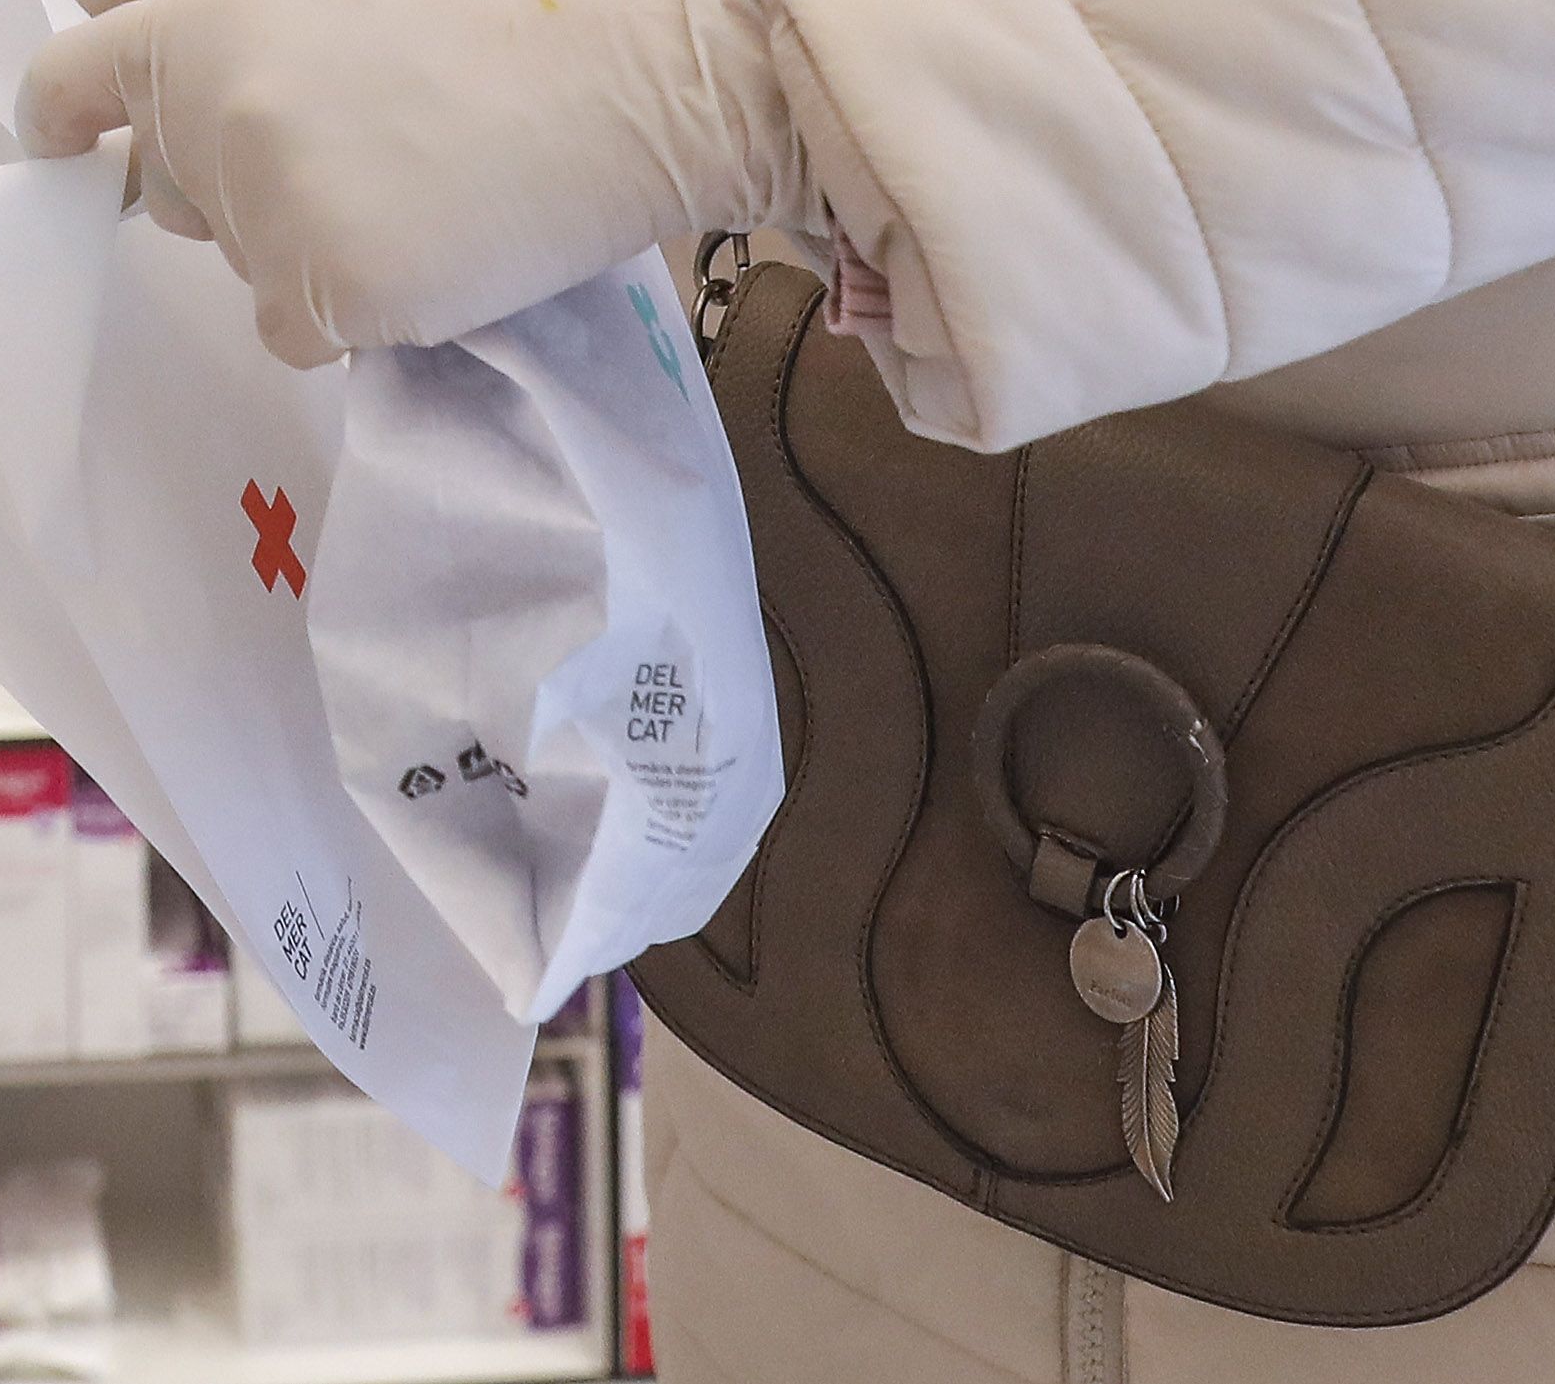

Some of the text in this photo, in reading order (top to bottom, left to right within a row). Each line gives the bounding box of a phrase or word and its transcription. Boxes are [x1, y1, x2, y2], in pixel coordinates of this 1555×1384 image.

[635, 663, 683, 689] DEL
[630, 690, 686, 716] MER
[626, 718, 674, 744] CAT
[273, 900, 298, 941] DEL
[282, 913, 308, 963] MER
[294, 937, 313, 981] CAT
